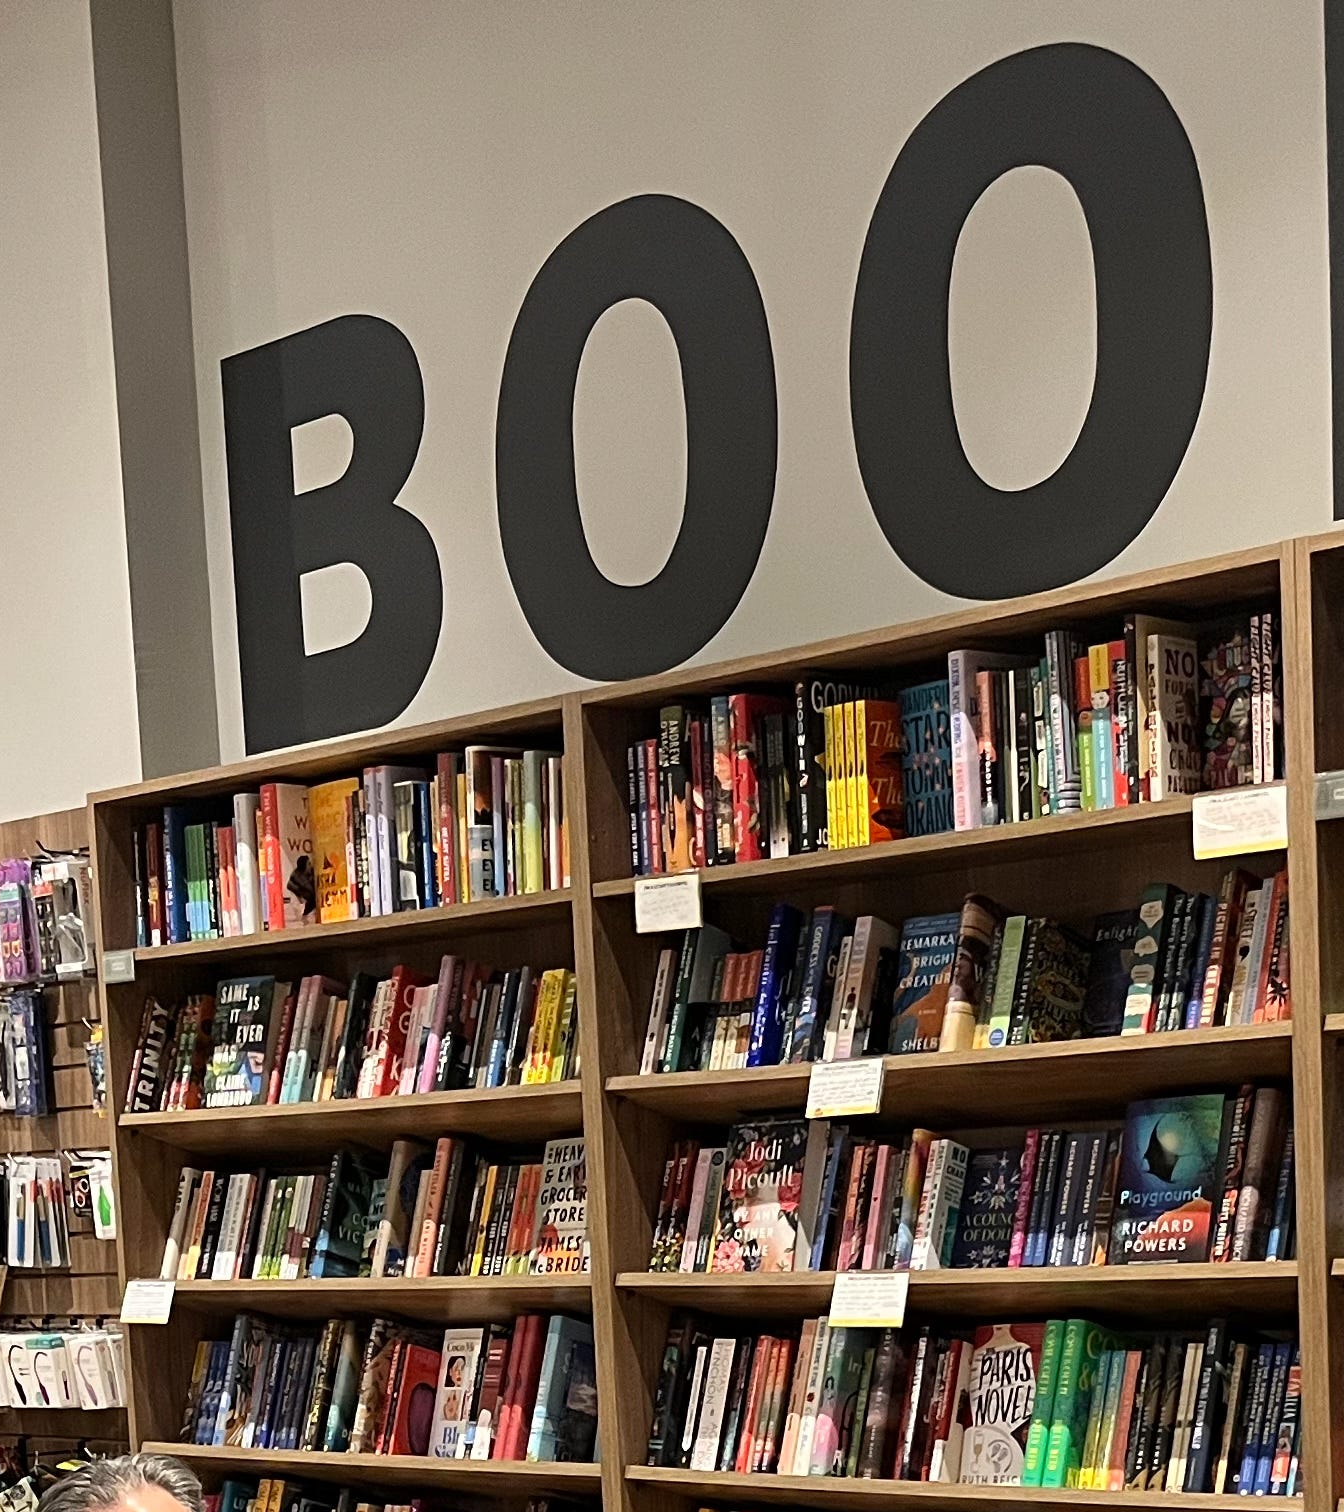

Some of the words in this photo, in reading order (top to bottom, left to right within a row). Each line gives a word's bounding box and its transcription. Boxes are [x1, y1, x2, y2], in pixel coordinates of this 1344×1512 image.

[668, 719, 679, 766] ANDREW
[902, 932, 959, 952] REMARKA
[912, 952, 957, 969] BRIGHT
[899, 971, 953, 989] CREATUR
[220, 982, 250, 1004] SAME
[247, 995, 260, 1012] AS
[229, 1008, 241, 1024] IT
[235, 1024, 263, 1043] EVER
[134, 1000, 175, 1112] TRINITY
[212, 1045, 237, 1065] WAS
[214, 1074, 246, 1092] CLAIRE
[746, 1139, 782, 1162] Jodi
[544, 1168, 555, 1183] &
[727, 1165, 795, 1192] Picoult
[321, 1181, 335, 1222] VICTORY
[1060, 1178, 1069, 1215] POWERS
[1120, 1186, 1202, 1206] Playground
[544, 1207, 585, 1225] STORE
[973, 1212, 1013, 1227] COUNC
[734, 1227, 773, 1241] OTHER
[963, 1229, 979, 1242] OF
[981, 1227, 1012, 1242] DOL
[1122, 1218, 1194, 1236] RICHARD
[537, 1235, 583, 1255] JAMES
[734, 1245, 769, 1257] NAME
[1124, 1237, 1187, 1253] POWERS
[528, 1255, 590, 1275] McBRIDE
[978, 1349, 1034, 1390] PARIS
[975, 1385, 1034, 1426] NOVEL
[962, 1474, 989, 1484] RUTH
[992, 1475, 1021, 1484] REIC
